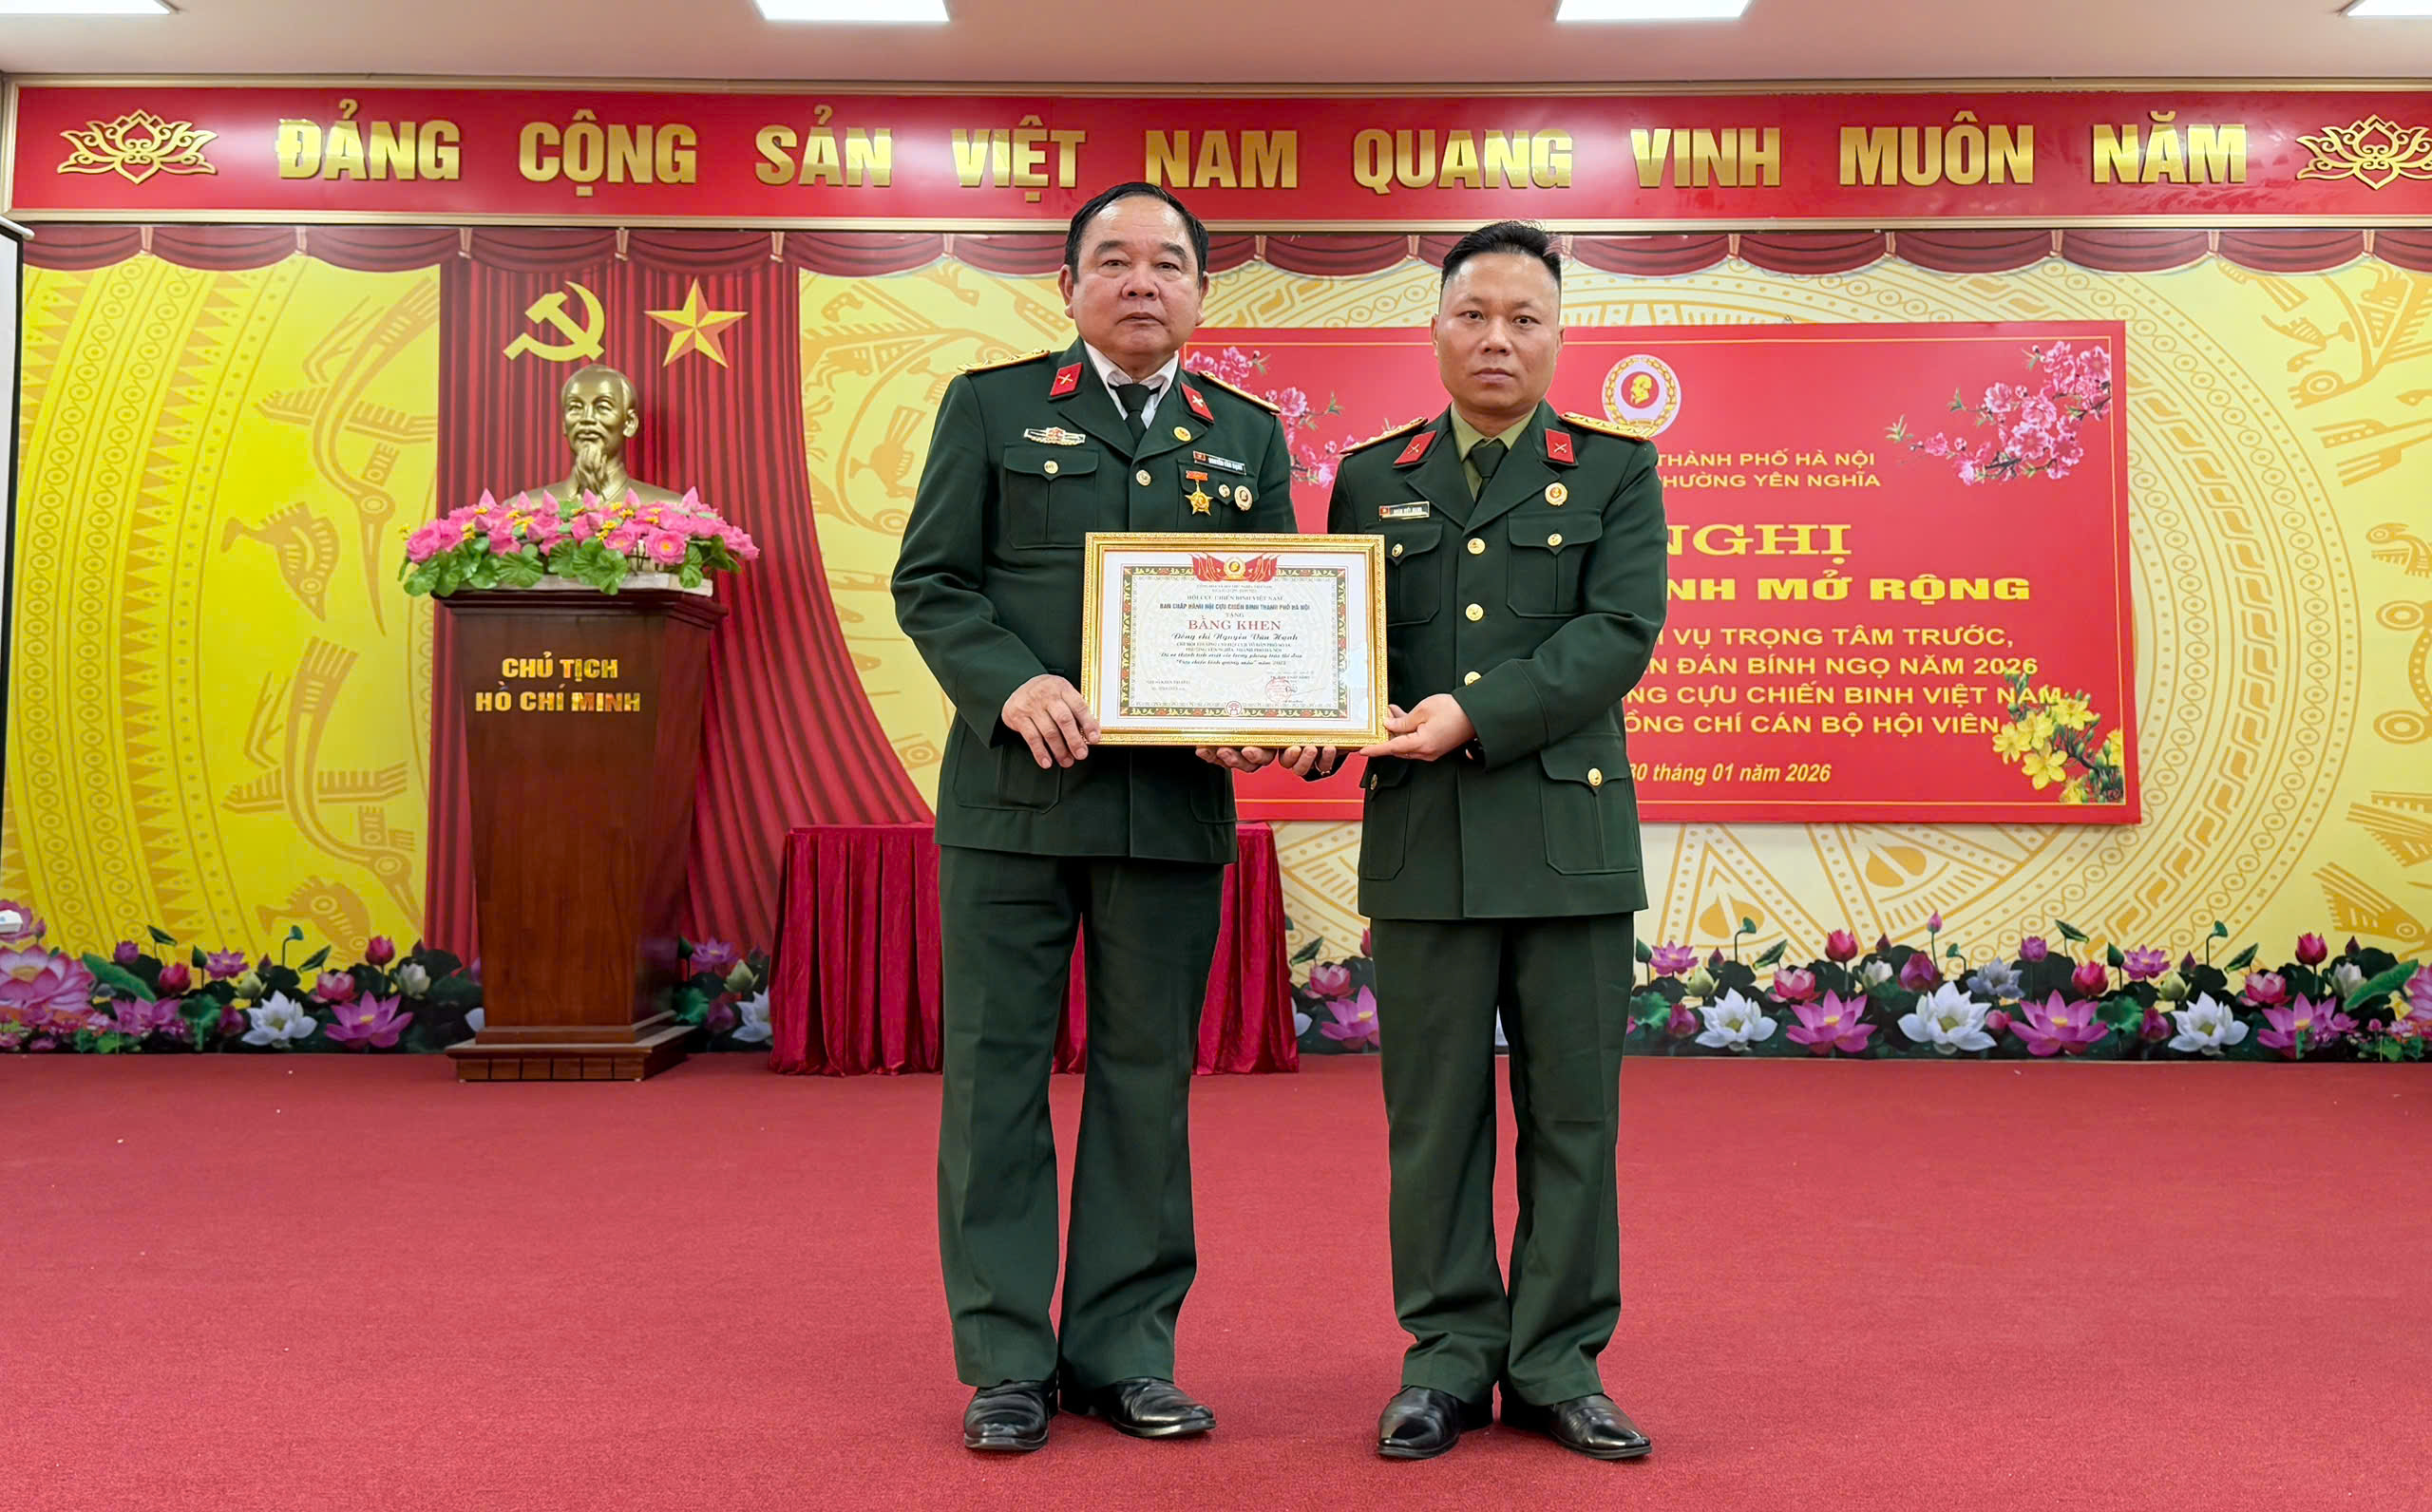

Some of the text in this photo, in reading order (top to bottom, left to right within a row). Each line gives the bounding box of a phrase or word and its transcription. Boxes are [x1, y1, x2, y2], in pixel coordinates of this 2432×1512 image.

[276, 99, 2247, 202] ĐẢNG CỘNG SẢN VIỆT NAM QUANG VINH MUÔN NĂM
[1739, 448, 1789, 466] PHỐ
[1796, 450, 1826, 466] HÀ
[1834, 450, 1875, 469] NỘI
[1662, 471, 1881, 488] HƯỜNG YÊN NGHĨA
[1758, 569, 1852, 601] MỞ
[1870, 574, 2030, 605] RỘNG
[1188, 615, 1282, 631] BẰNG KHEN
[1673, 628, 1712, 650] VỤ
[1720, 628, 1824, 650] TRỌNG
[1832, 624, 1893, 646] TÂM
[1903, 624, 2014, 649] TRƯỚC,
[502, 651, 618, 682] CHỦ TỊCH
[1677, 653, 1738, 674] ĐÁN
[1748, 653, 1816, 674] BÍNH
[1826, 657, 1890, 679] NGỌ
[1900, 654, 1965, 674] NĂM
[1973, 657, 2039, 675] 2026
[475, 680, 641, 712] HỒ CHÍ MINH
[1677, 685, 1738, 708] CỰU
[1746, 680, 1835, 704] CHIẾN
[1845, 687, 1914, 705] BINH
[1923, 683, 1987, 709] VIỆT
[1997, 686, 2062, 705] NAM
[1624, 709, 2000, 738] ỒNG CHÍ CÁN BỘ HỘI VIÊN
[1653, 762, 1707, 786] tháng
[1712, 763, 1735, 783] 01
[1739, 764, 1781, 782] năm
[1785, 763, 1833, 783] 2026
